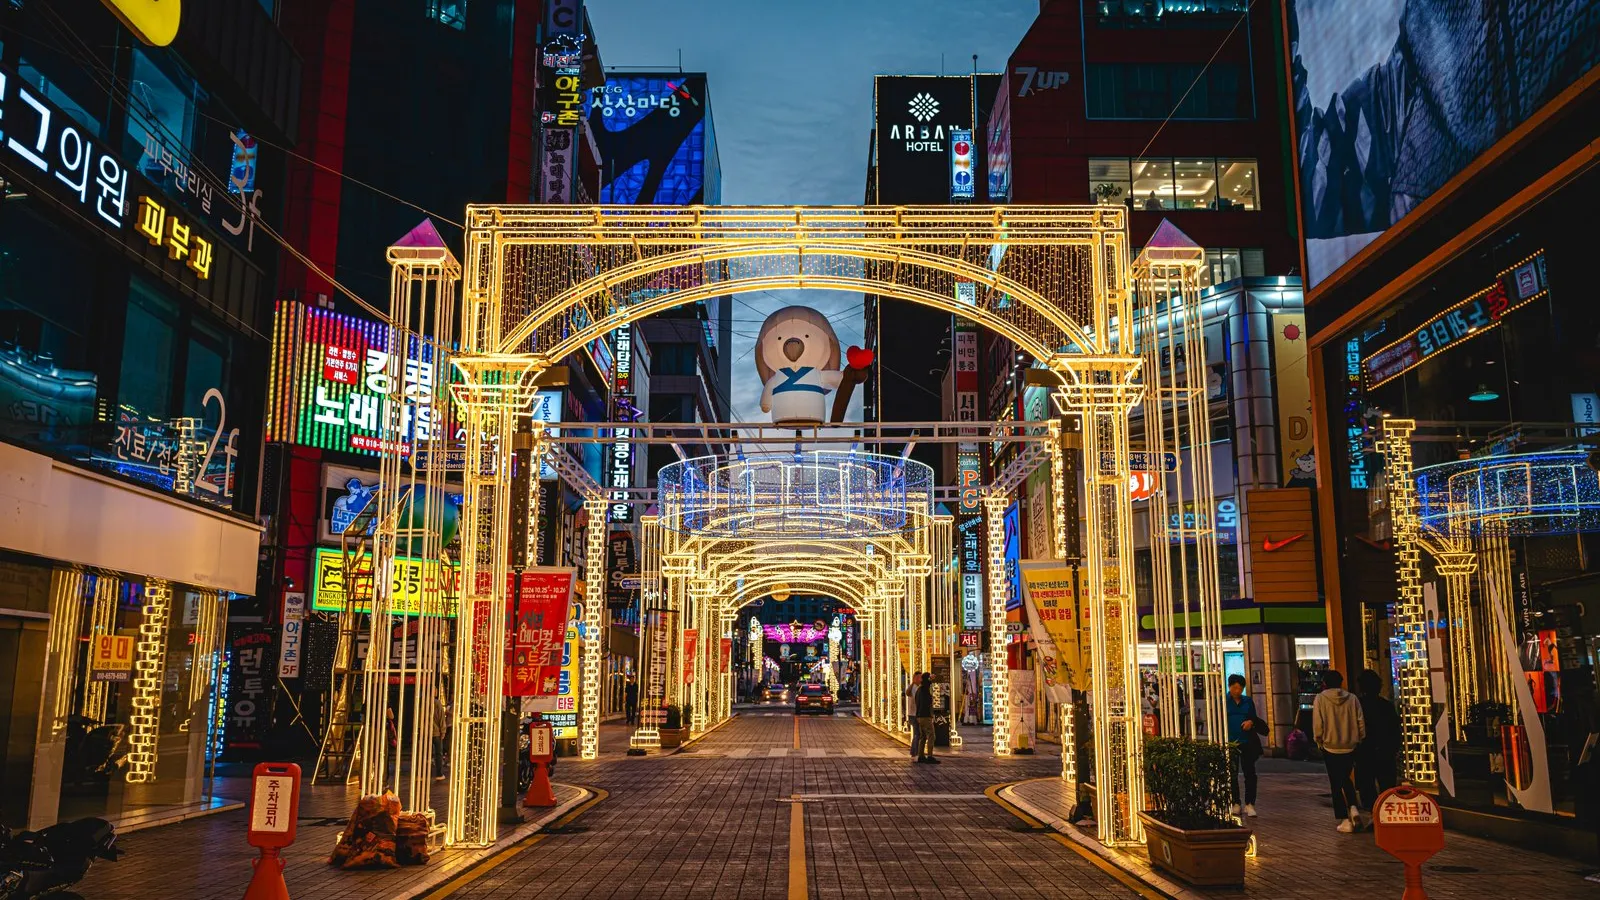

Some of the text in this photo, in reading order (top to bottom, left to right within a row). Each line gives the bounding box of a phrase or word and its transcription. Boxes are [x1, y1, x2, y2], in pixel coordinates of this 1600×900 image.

[555, 76, 580, 125] 야구존
[591, 85, 623, 94] KT&G
[1015, 66, 1069, 97] 7UP
[541, 111, 556, 123] 5F
[591, 94, 681, 117] 상상마당
[0, 71, 128, 229] 그의원
[906, 141, 944, 152] HOTEL
[140, 196, 213, 280] 피부과
[313, 386, 442, 441] 노래타운
[963, 469, 978, 509] PC
[964, 530, 978, 571] 노래타운
[965, 575, 978, 624] 인앤아웃
[1521, 591, 1528, 606] ON
[101, 636, 129, 660] 임대
[284, 621, 300, 662] 야구존
[232, 647, 264, 728] 런투유
[281, 664, 297, 675] 5F
[264, 779, 281, 828] 주차금지
